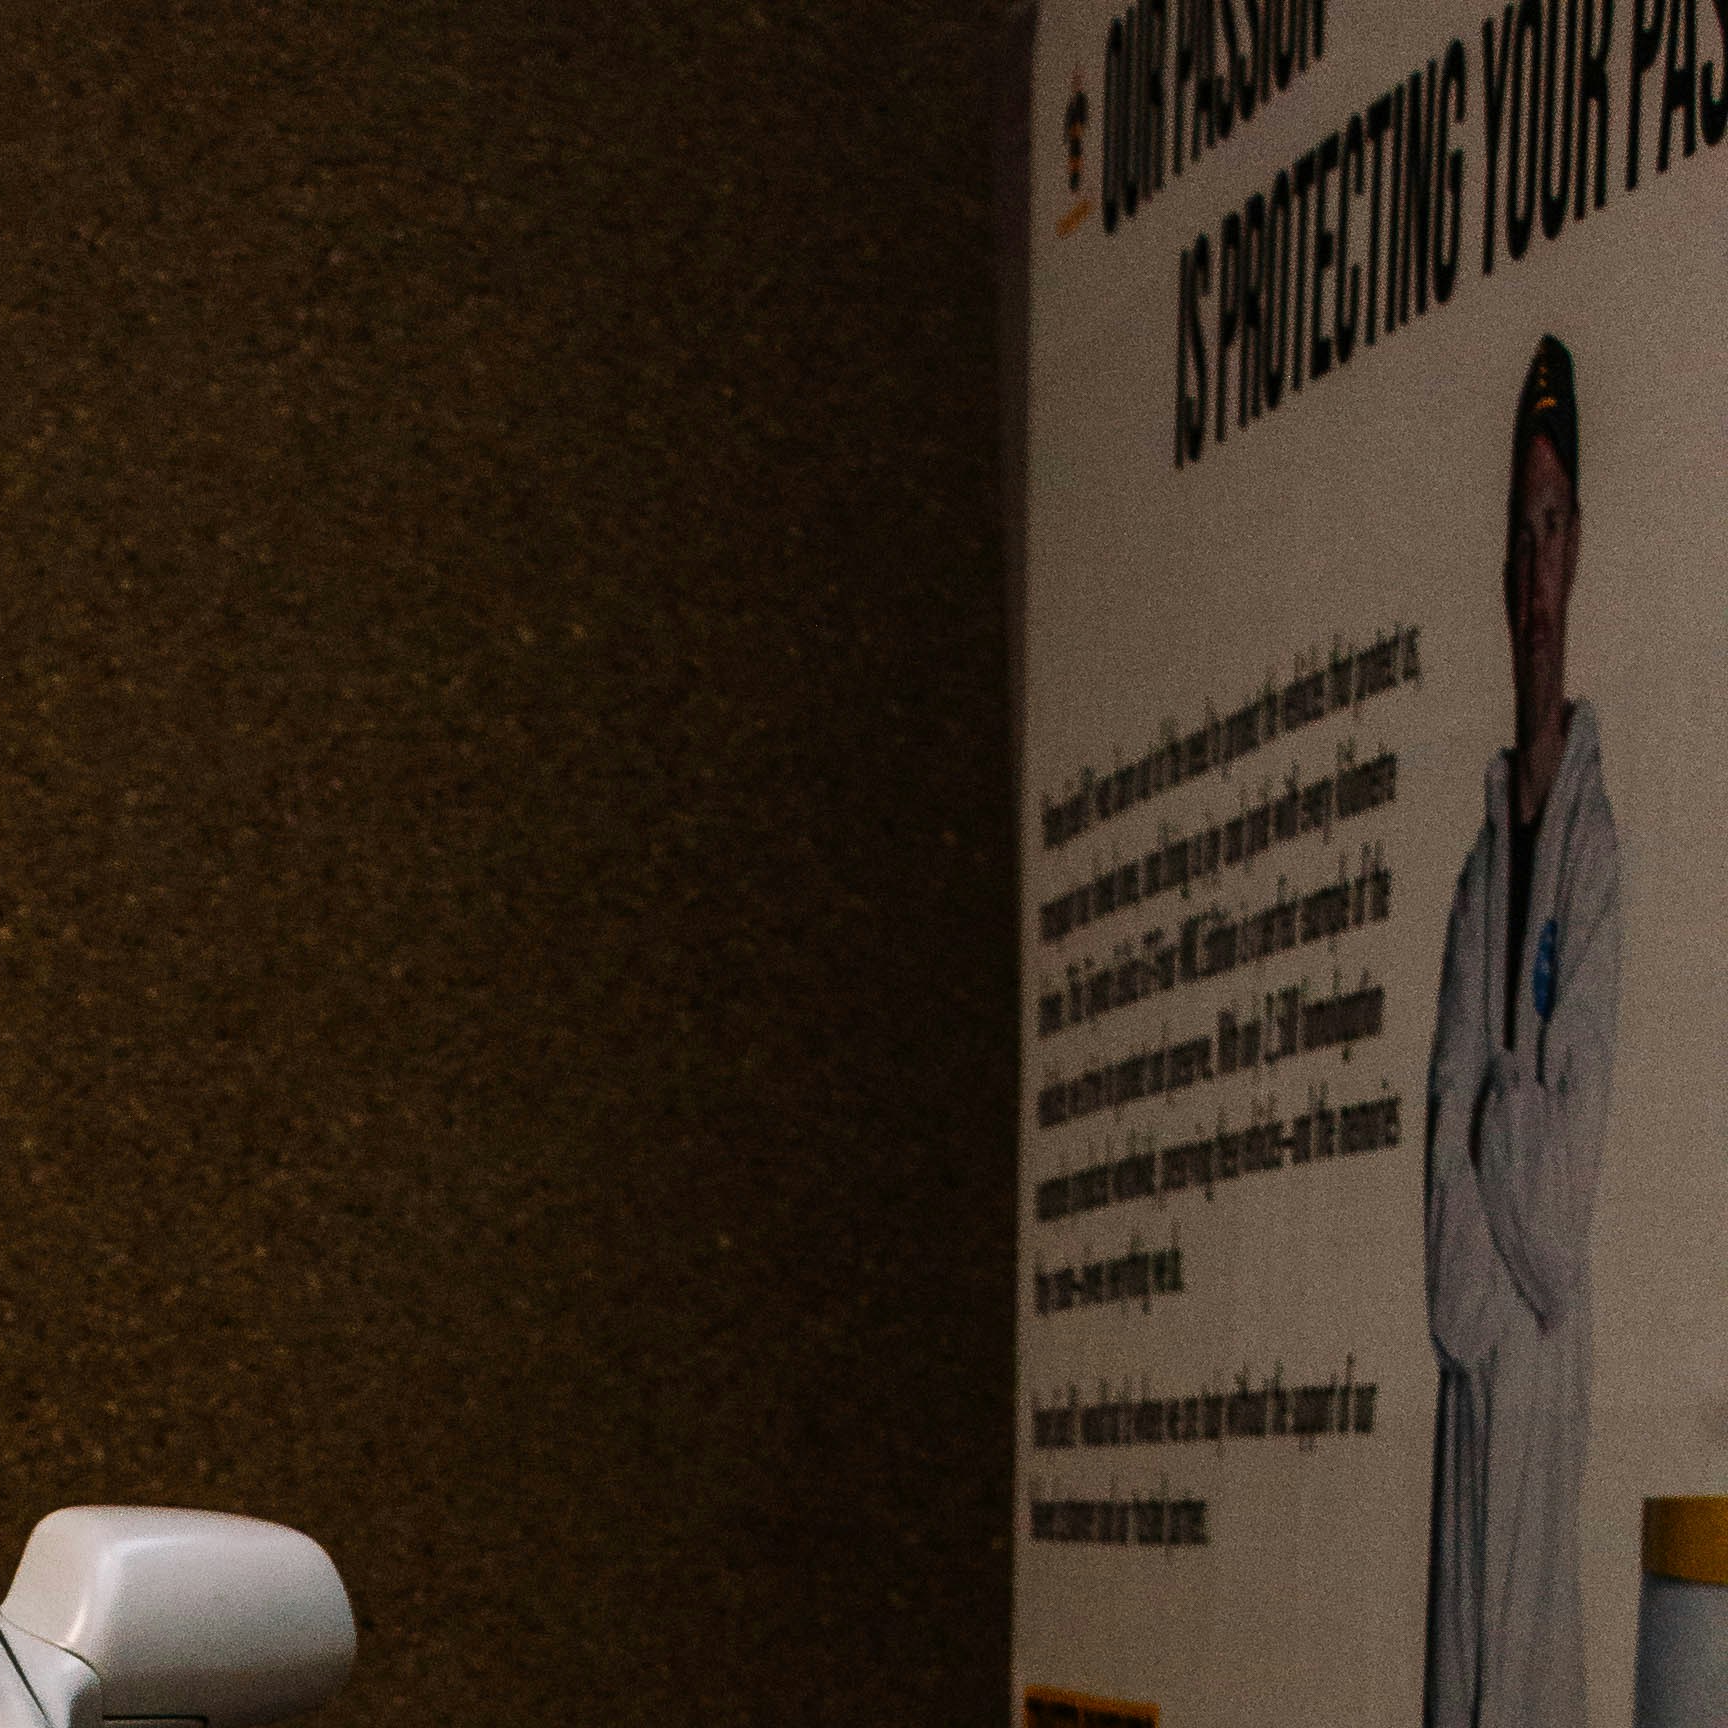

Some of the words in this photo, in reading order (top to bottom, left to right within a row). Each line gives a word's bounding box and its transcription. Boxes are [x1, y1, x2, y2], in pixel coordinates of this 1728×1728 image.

[1101, 0, 1165, 235] OUR
[1175, 232, 1210, 470] IS
[1217, 38, 1465, 442] PROTECTING
[1480, 0, 1615, 276] YOUR
